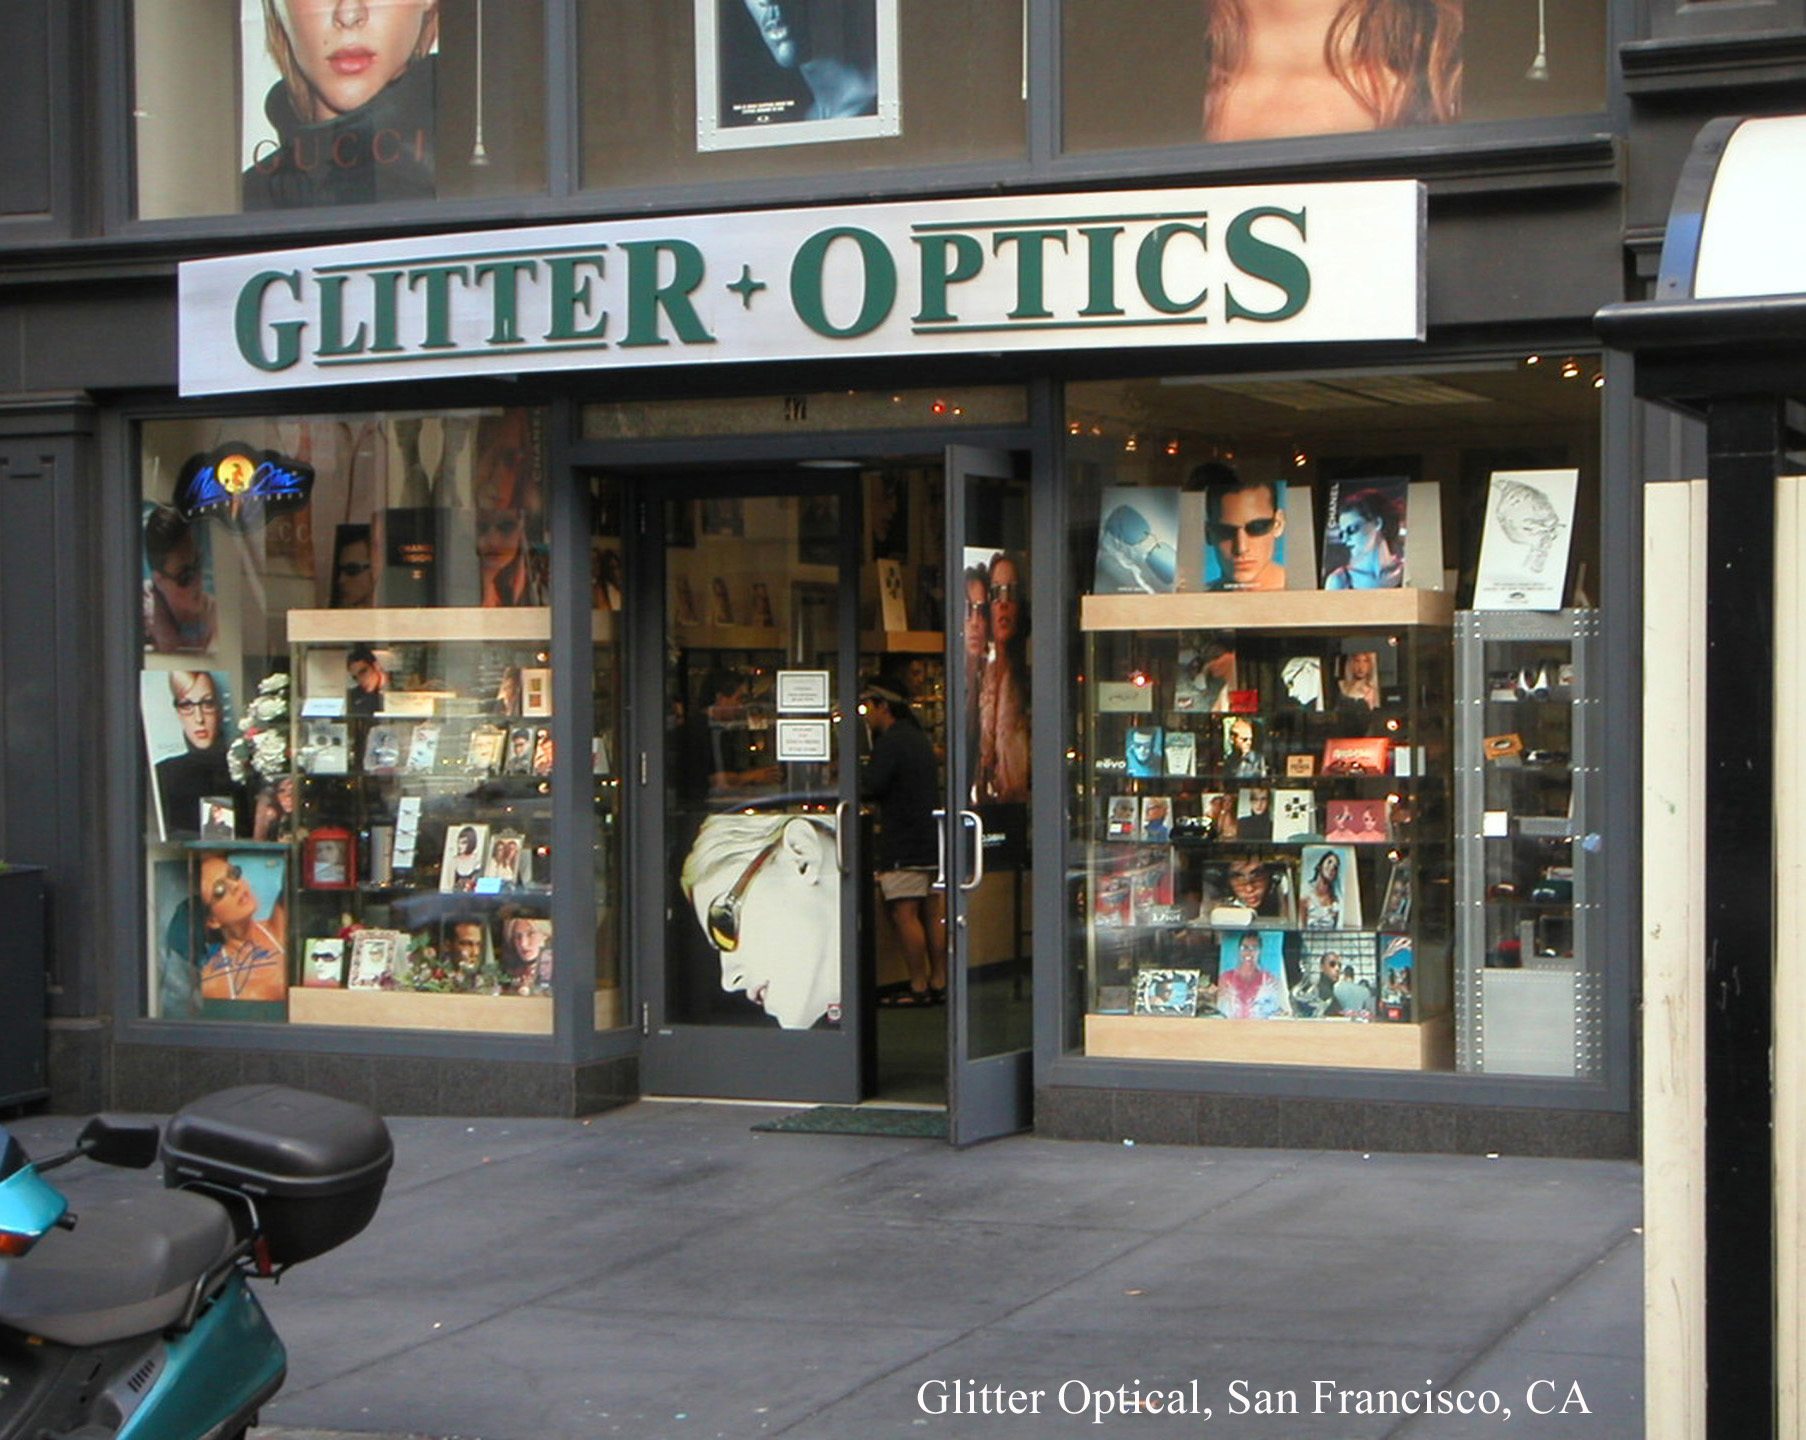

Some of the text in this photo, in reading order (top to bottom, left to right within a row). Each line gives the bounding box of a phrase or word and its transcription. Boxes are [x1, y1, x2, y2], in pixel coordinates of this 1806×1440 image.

[253, 127, 426, 174] GUCCI
[234, 206, 1312, 372] GLITTER OPTICS
[1328, 482, 1340, 529] CHANEL
